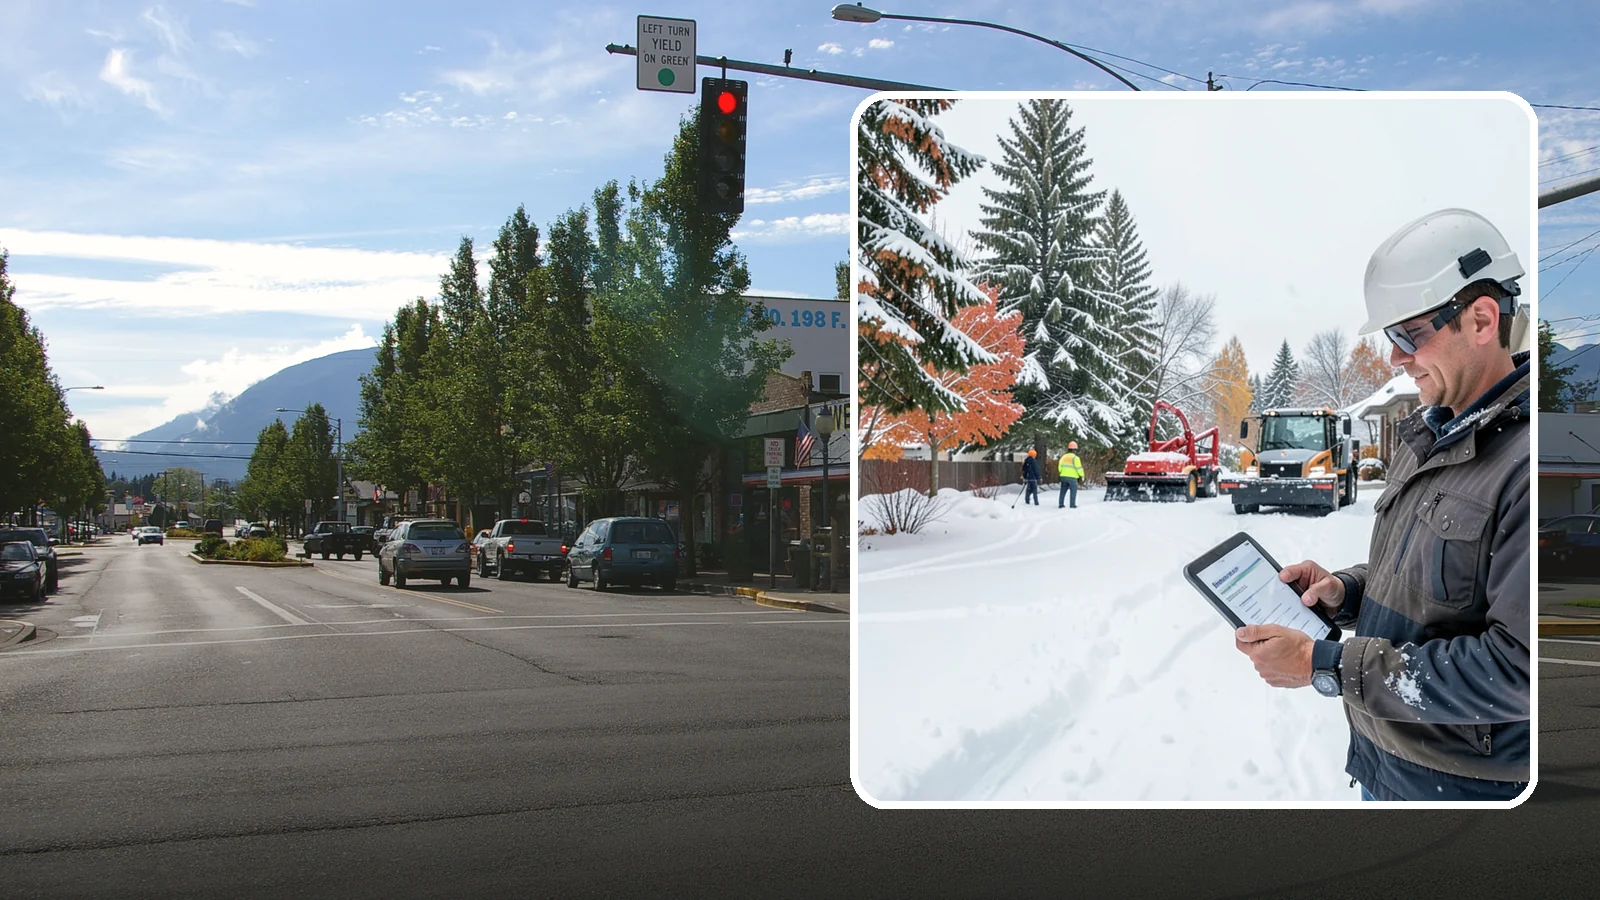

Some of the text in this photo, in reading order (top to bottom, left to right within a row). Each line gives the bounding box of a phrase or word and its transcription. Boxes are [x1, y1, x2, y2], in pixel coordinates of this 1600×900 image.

[643, 24, 690, 36] LEFT TURN
[652, 38, 681, 51] YIELD
[644, 53, 688, 66] ON GREEN
[763, 308, 786, 327] O.
[791, 309, 826, 328] 198
[831, 311, 846, 329] F.
